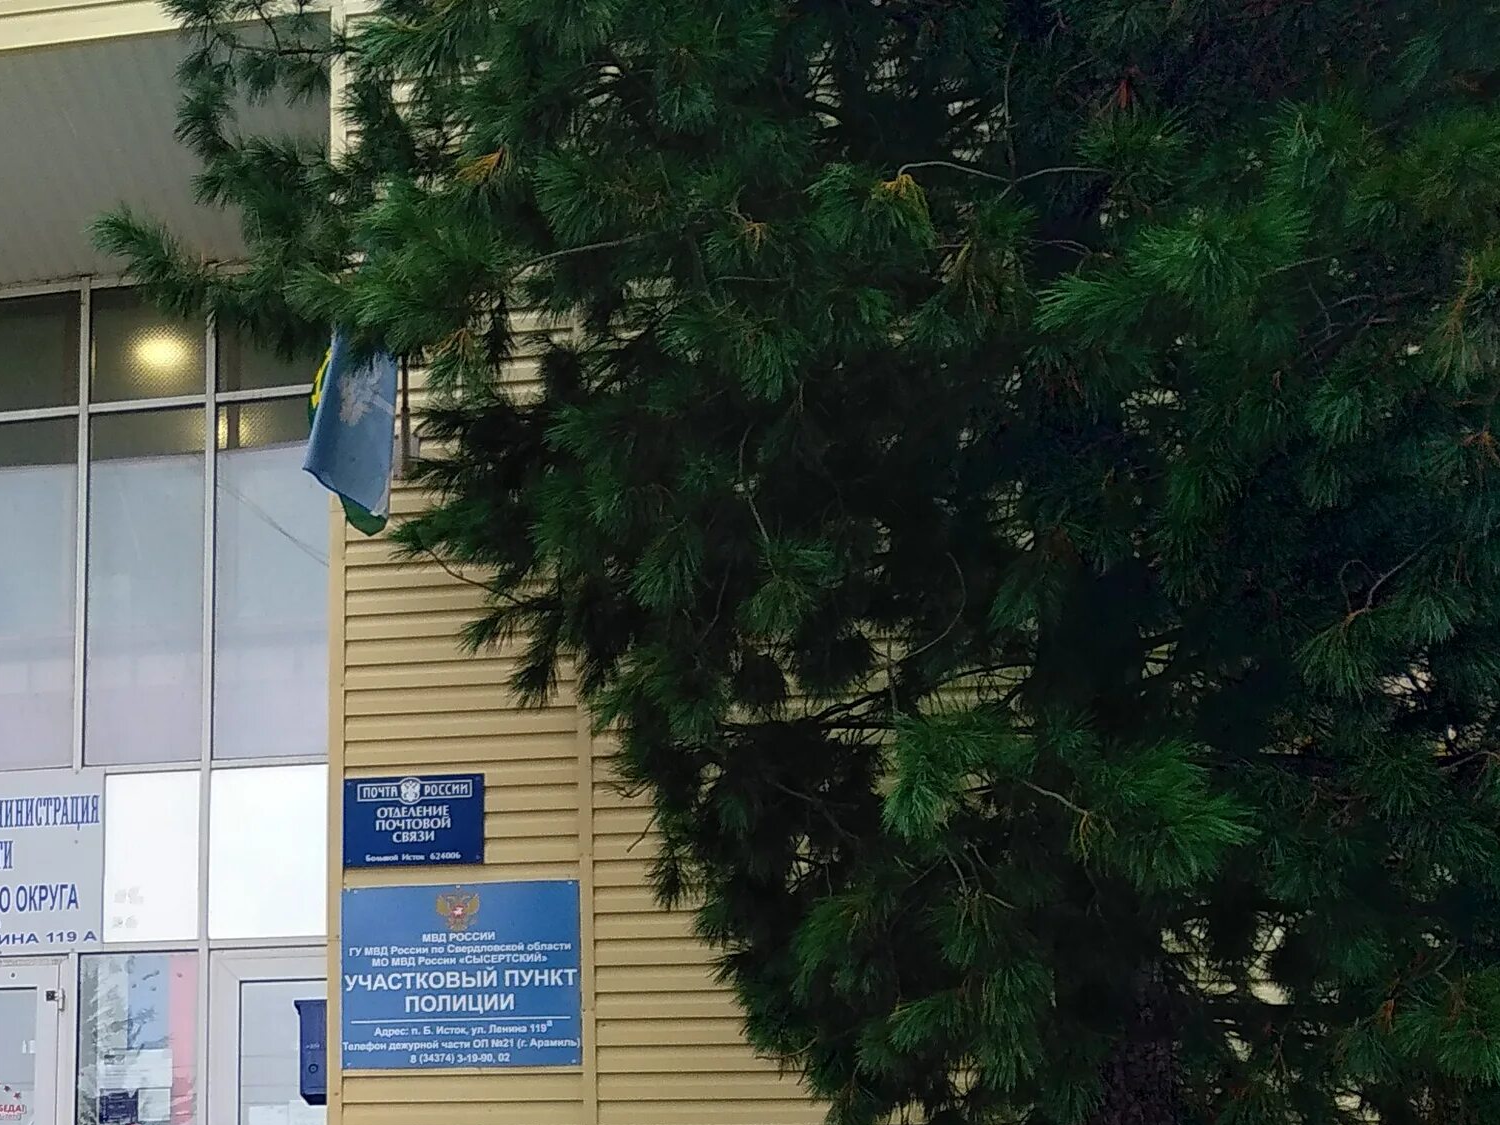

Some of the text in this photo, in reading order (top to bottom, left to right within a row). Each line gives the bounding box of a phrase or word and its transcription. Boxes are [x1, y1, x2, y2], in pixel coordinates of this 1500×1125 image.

[362, 783, 469, 799] ПОЧТА РОССИИ
[376, 804, 450, 819] ОТДЕЛЕНИЕ
[375, 815, 452, 832] ПОЧТОВОЙ
[392, 830, 435, 843] СВЯЗИ
[429, 851, 462, 861] 624006
[15, 883, 79, 912] ОКРУГА
[46, 931, 78, 943] 119
[83, 930, 98, 942] А
[422, 931, 496, 943] МВД РОССИИ
[348, 941, 572, 957] ГУ МВД России по Свердловской области
[371, 952, 548, 968] МО МВД России «СЫСЕРТСКИЙ»
[344, 966, 578, 992] УЧАСТКОВЫЙ ПУНКТ
[404, 993, 515, 1015] ПОЛИЦИИ
[373, 1026, 409, 1038] Адрес:
[410, 1027, 421, 1035] п.
[423, 1026, 434, 1035] Б.
[435, 1025, 469, 1036] Исток,
[471, 1025, 487, 1037] ул.
[488, 1024, 528, 1034] Ленина
[342, 1041, 387, 1052] Телефон
[388, 1040, 439, 1052] дежурной
[441, 1040, 471, 1050] части
[472, 1038, 489, 1049] ОП
[490, 1038, 514, 1048] №21
[529, 1037, 580, 1049] Арамиль)
[409, 1054, 417, 1064] 8
[419, 1053, 455, 1064] (34374)
[497, 1052, 511, 1062] 02
